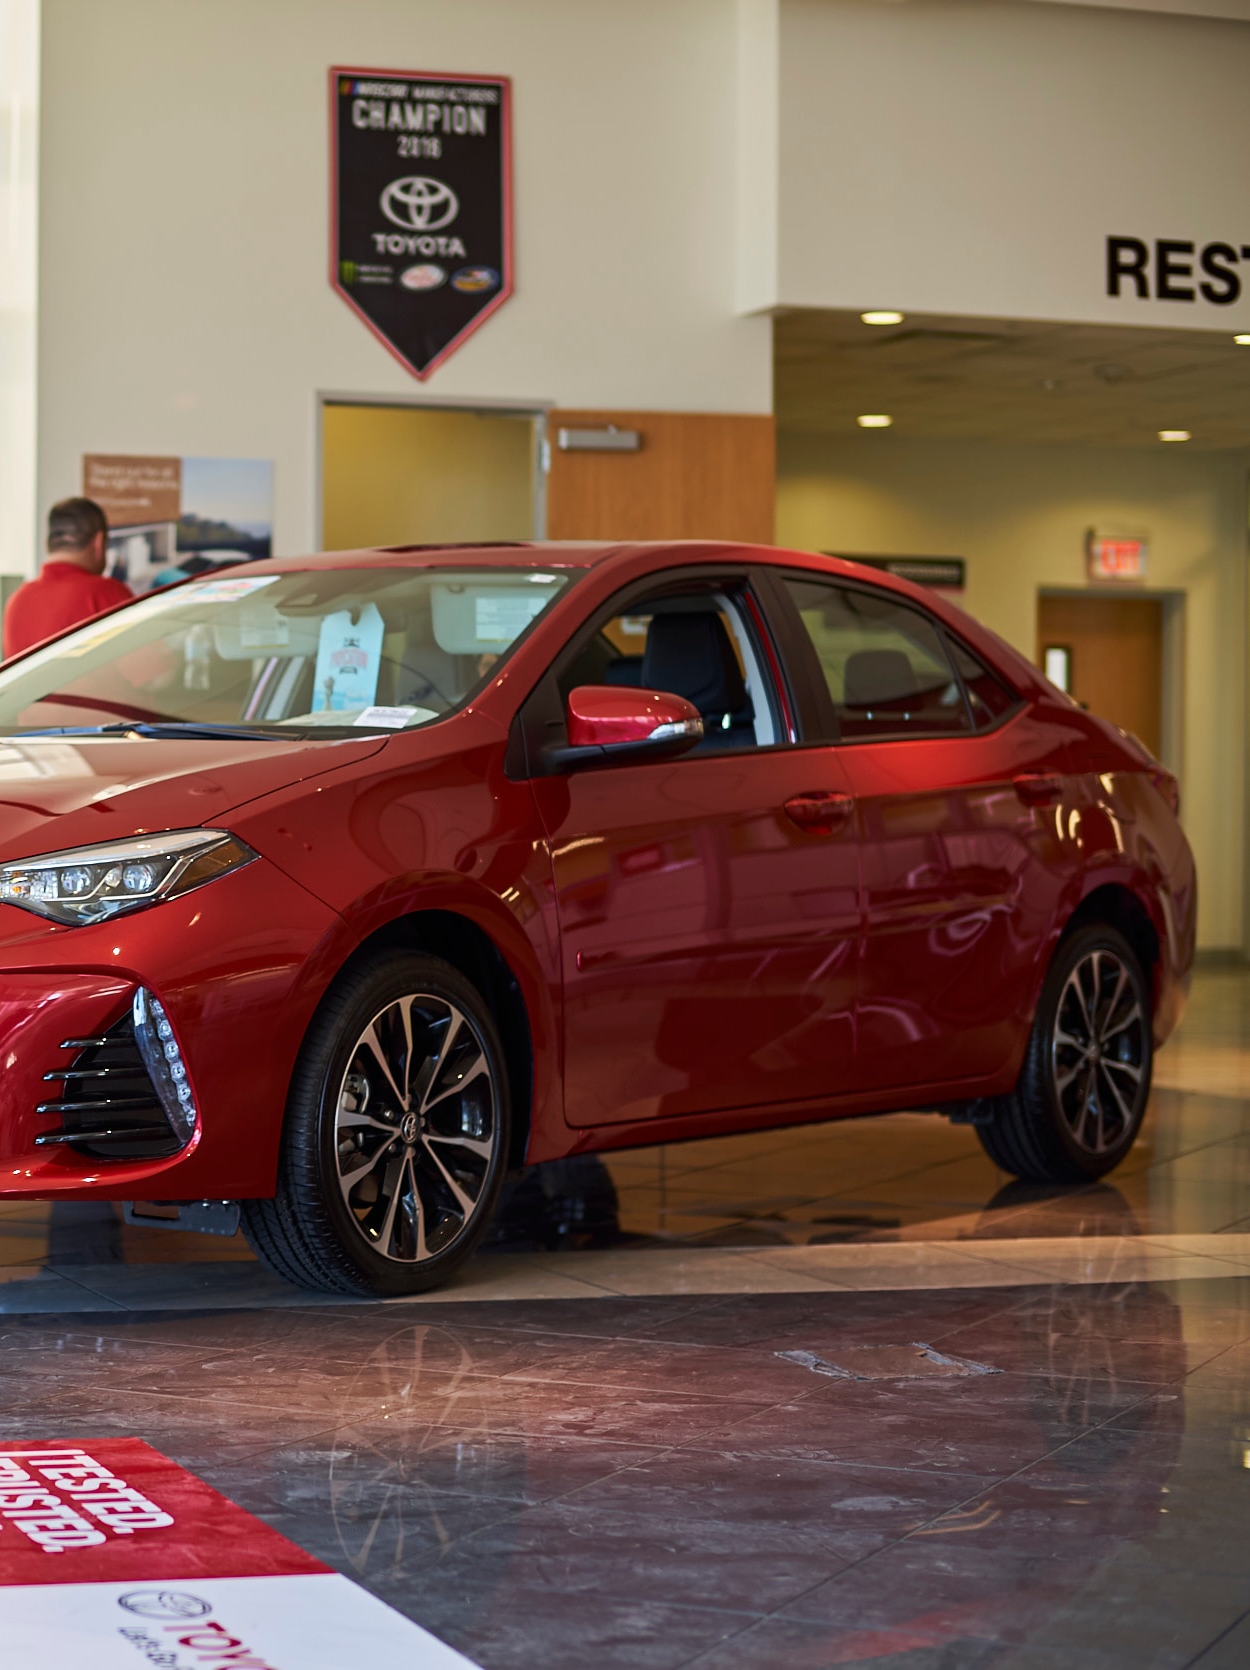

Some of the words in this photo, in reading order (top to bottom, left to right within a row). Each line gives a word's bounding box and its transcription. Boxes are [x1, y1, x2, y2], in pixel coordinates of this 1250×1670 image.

[352, 99, 486, 135] CHAMPION
[371, 233, 467, 258] TOYOTA
[1106, 235, 1250, 305] RES
[28, 1453, 175, 1534] TESTED.
